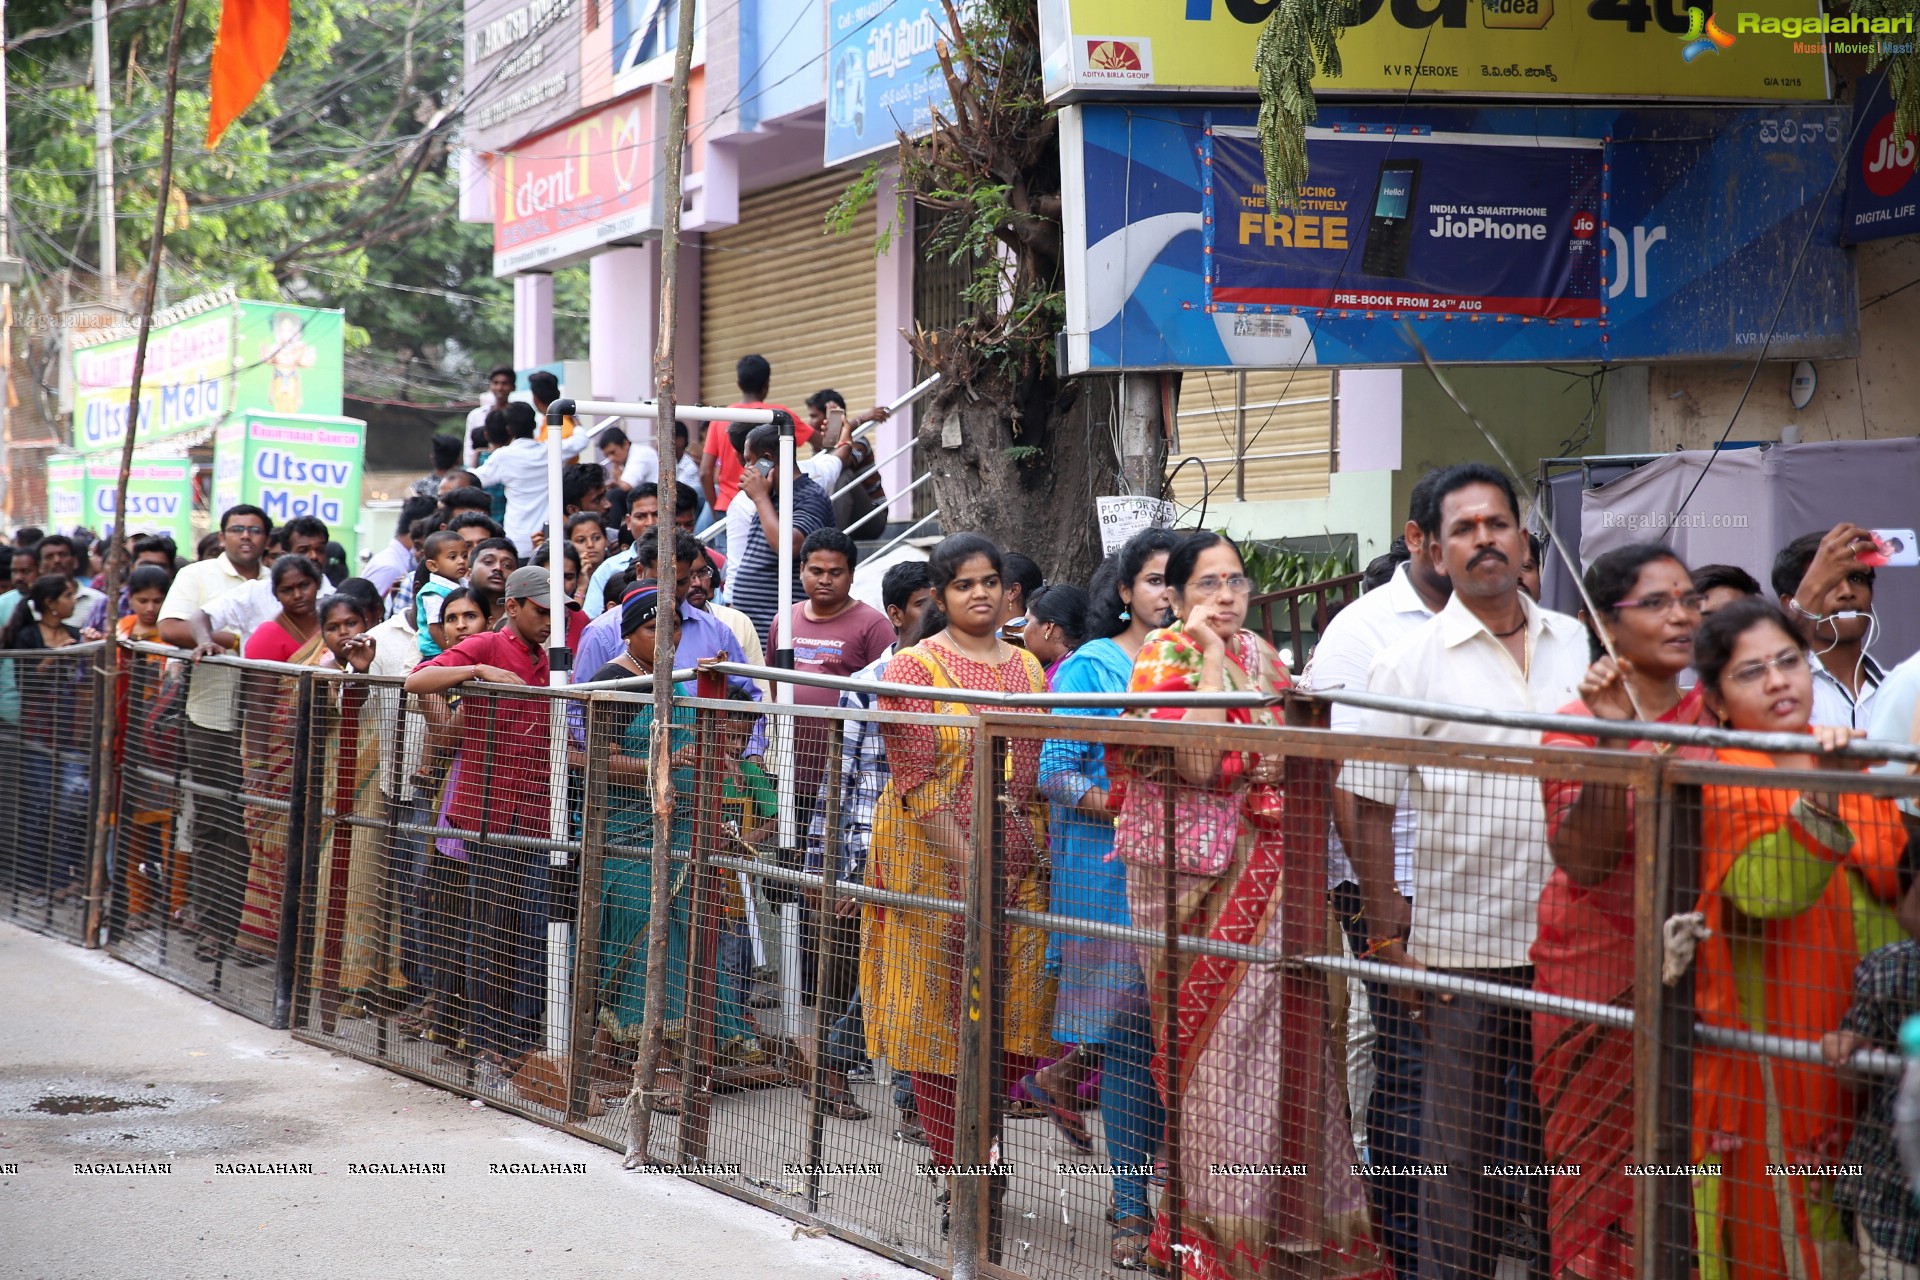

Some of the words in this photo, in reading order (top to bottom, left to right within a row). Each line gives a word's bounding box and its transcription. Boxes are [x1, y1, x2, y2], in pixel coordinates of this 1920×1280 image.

[1384, 65, 1391, 75] K
[1394, 65, 1402, 75] V
[1404, 65, 1412, 75] R
[1414, 66, 1458, 77] XEROXE
[1764, 77, 1779, 87] G/A
[1781, 78, 1802, 87] 12/15
[1869, 132, 1915, 173] Jio
[1383, 187, 1405, 196] Hello!
[1240, 196, 1265, 208] THE
[1430, 204, 1457, 214] INDIA
[1460, 205, 1475, 215] KA
[1477, 206, 1547, 217] SMARTPHONE
[1855, 211, 1892, 225] DIGITAL
[1894, 204, 1916, 218] LIFE
[1239, 212, 1349, 250] FREE
[1429, 215, 1547, 241] JioPhone
[1573, 218, 1594, 231] Jio
[1334, 294, 1393, 306] PRE-BOOK
[1396, 297, 1429, 308] FROM
[1459, 301, 1482, 310] AUG
[1735, 333, 1757, 344] KVR
[161, 375, 219, 425] Mela
[258, 452, 348, 484] Utsav
[263, 490, 339, 522] Mela
[1101, 503, 1126, 514] PLOT
[1130, 502, 1149, 511] FOR
[1151, 504, 1172, 516] SALE
[1103, 514, 1118, 525] 80
